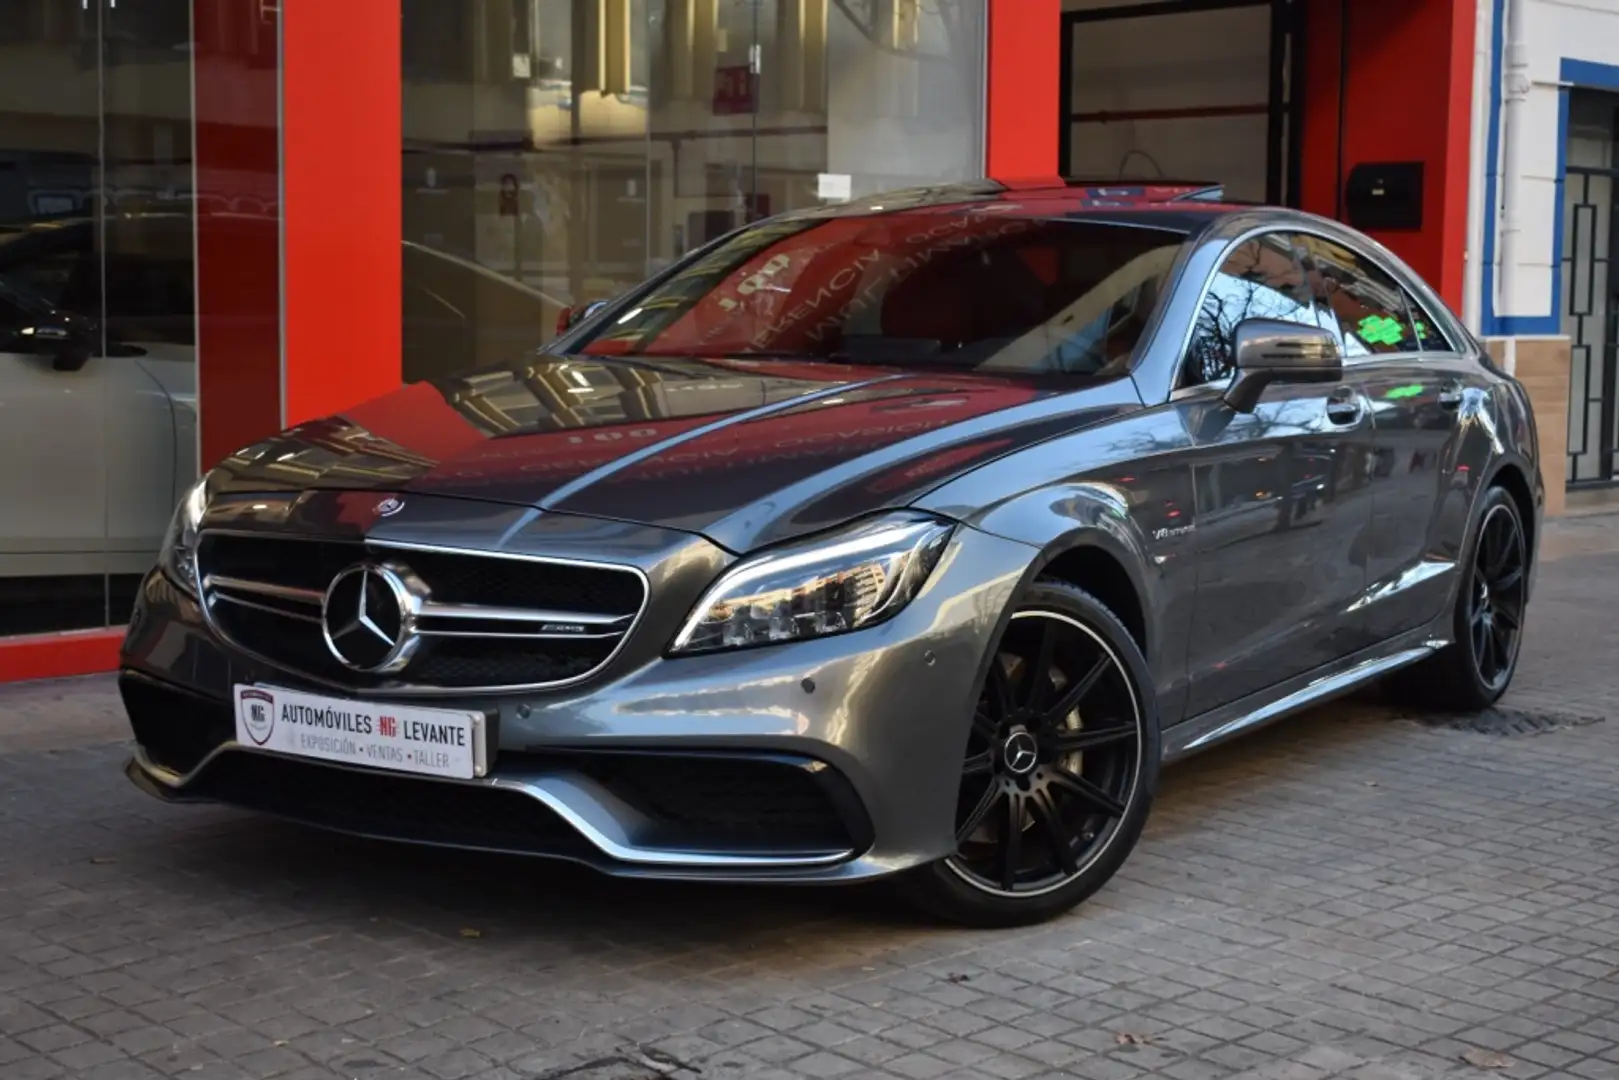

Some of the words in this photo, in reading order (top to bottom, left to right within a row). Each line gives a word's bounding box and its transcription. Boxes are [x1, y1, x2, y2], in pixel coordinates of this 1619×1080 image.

[281, 703, 372, 735] AUTOMÓVILES
[403, 721, 466, 747] LEVANTE
[300, 732, 357, 755] EXPOSICIÓN
[366, 743, 404, 762] VENTAS
[413, 749, 450, 769] TALLER
